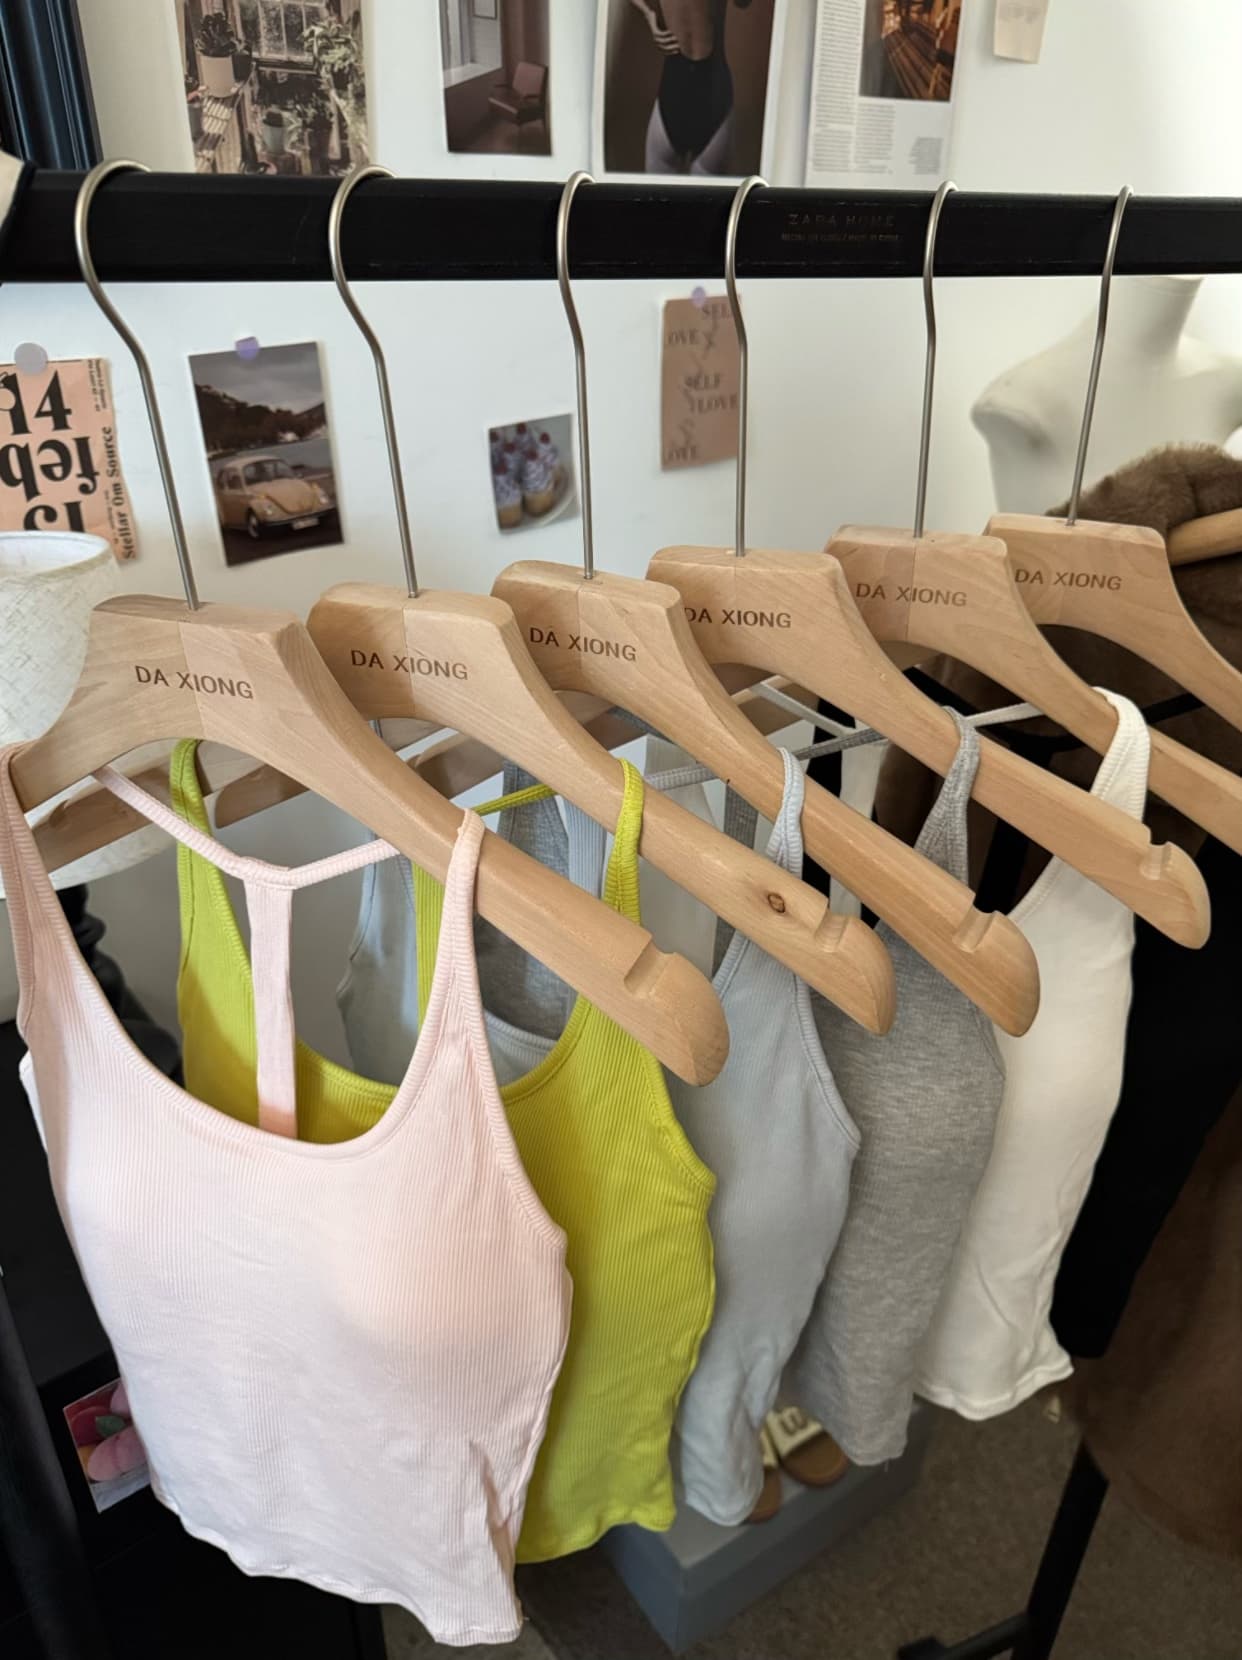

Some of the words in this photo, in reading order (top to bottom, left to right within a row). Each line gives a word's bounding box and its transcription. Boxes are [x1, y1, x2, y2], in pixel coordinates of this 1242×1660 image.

[787, 213, 837, 226] ZARA
[104, 426, 120, 479] Source
[0, 436, 100, 503] feb
[117, 511, 137, 561] Stellar
[856, 582, 886, 600] DA
[895, 586, 968, 607] XIONG
[1014, 568, 1043, 585] DA
[1053, 571, 1122, 591] XIONG
[684, 606, 713, 624] DA
[721, 608, 792, 629] XIONG
[529, 627, 560, 648] DA
[567, 634, 637, 662] XIONG
[350, 649, 385, 670] DA
[393, 654, 469, 681] XIONG
[135, 665, 170, 688] DA
[176, 671, 254, 700] XIONG
